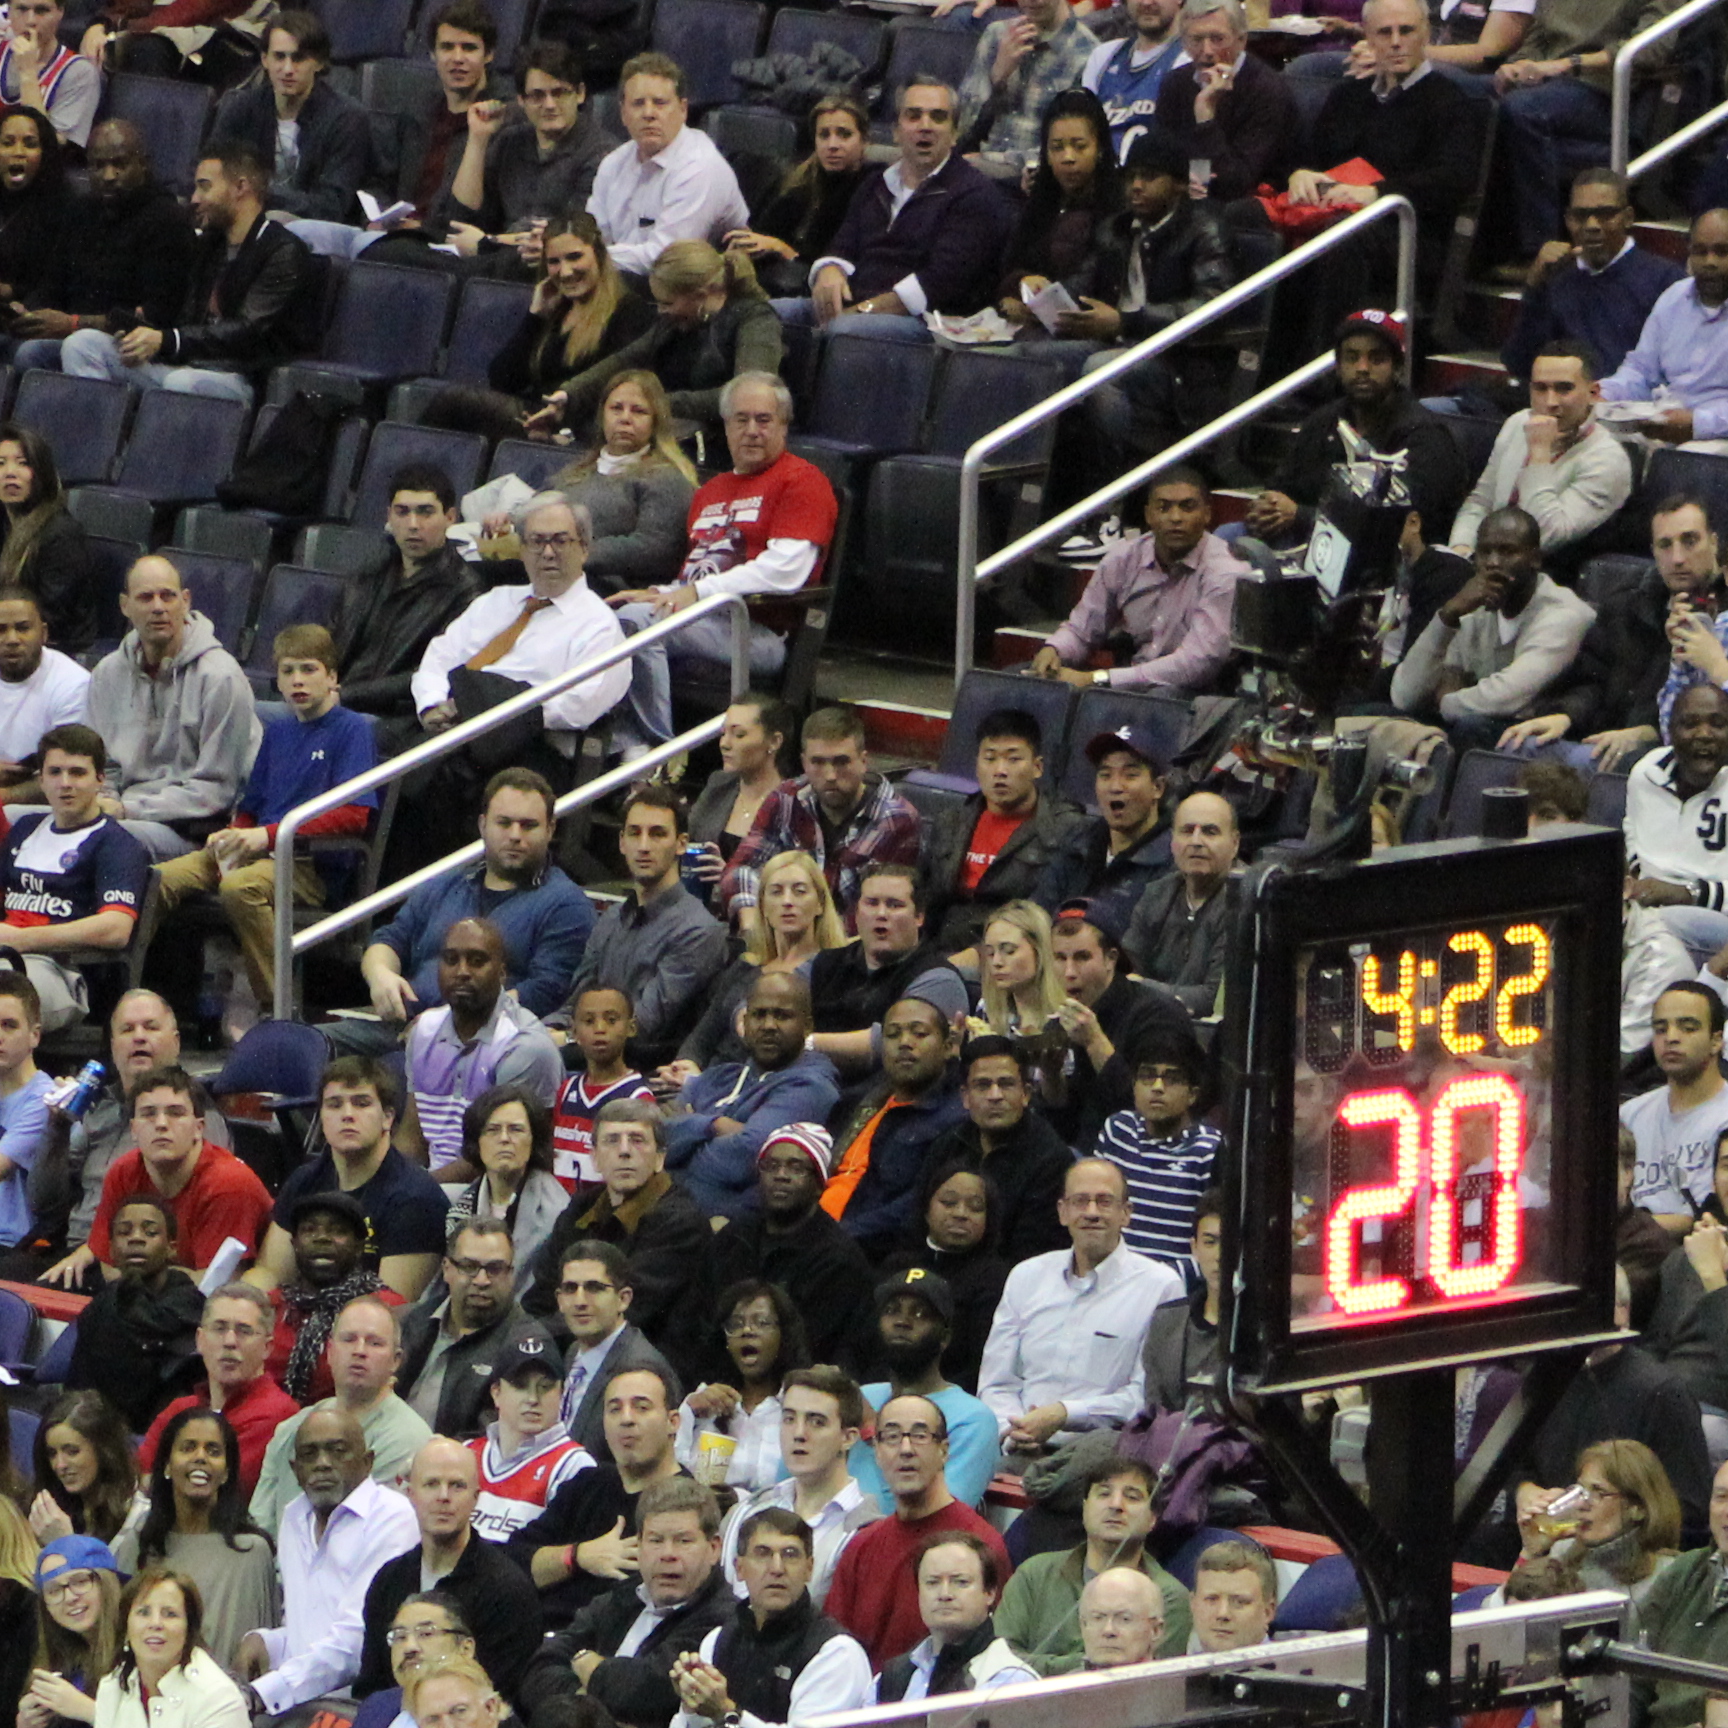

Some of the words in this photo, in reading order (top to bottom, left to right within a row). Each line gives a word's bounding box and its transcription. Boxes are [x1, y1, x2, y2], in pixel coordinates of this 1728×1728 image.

[20, 872, 45, 894] Fly
[3, 886, 74, 918] mirates
[103, 889, 136, 906] QNB
[1360, 923, 1551, 1057] 4:22
[1325, 1073, 1522, 1314] 20
[904, 1268, 927, 1284] P
[470, 1507, 525, 1533] ards
